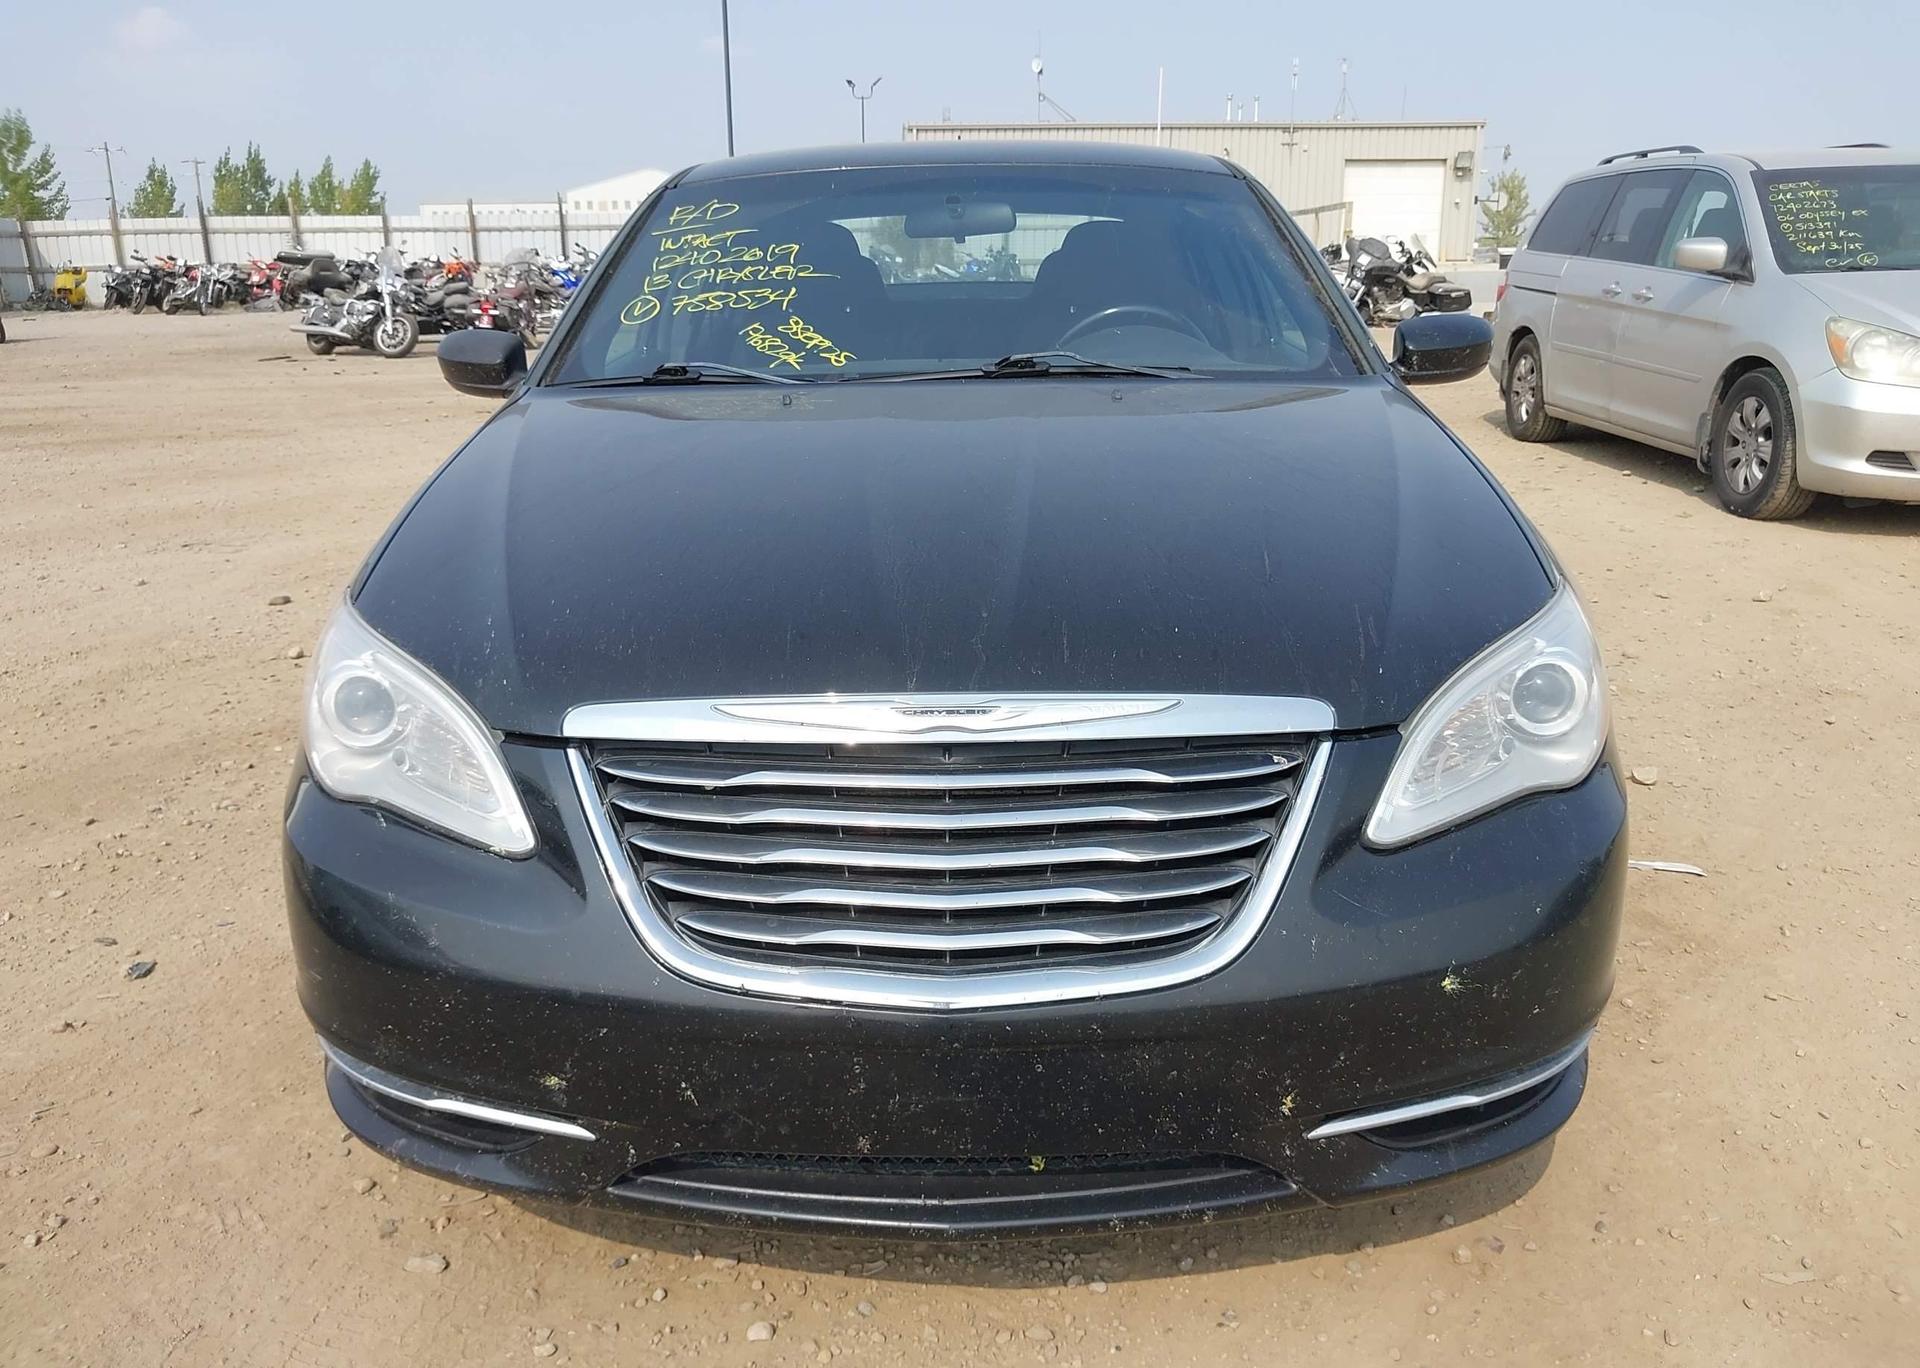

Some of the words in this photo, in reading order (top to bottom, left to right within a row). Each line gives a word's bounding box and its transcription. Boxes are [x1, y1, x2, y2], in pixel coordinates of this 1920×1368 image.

[1769, 191, 1796, 203] CAR
[1798, 189, 1839, 202] STARTS
[661, 229, 759, 251] INTACT
[677, 263, 841, 290] CHRYSLER
[900, 708, 992, 716] CHRYSLER
